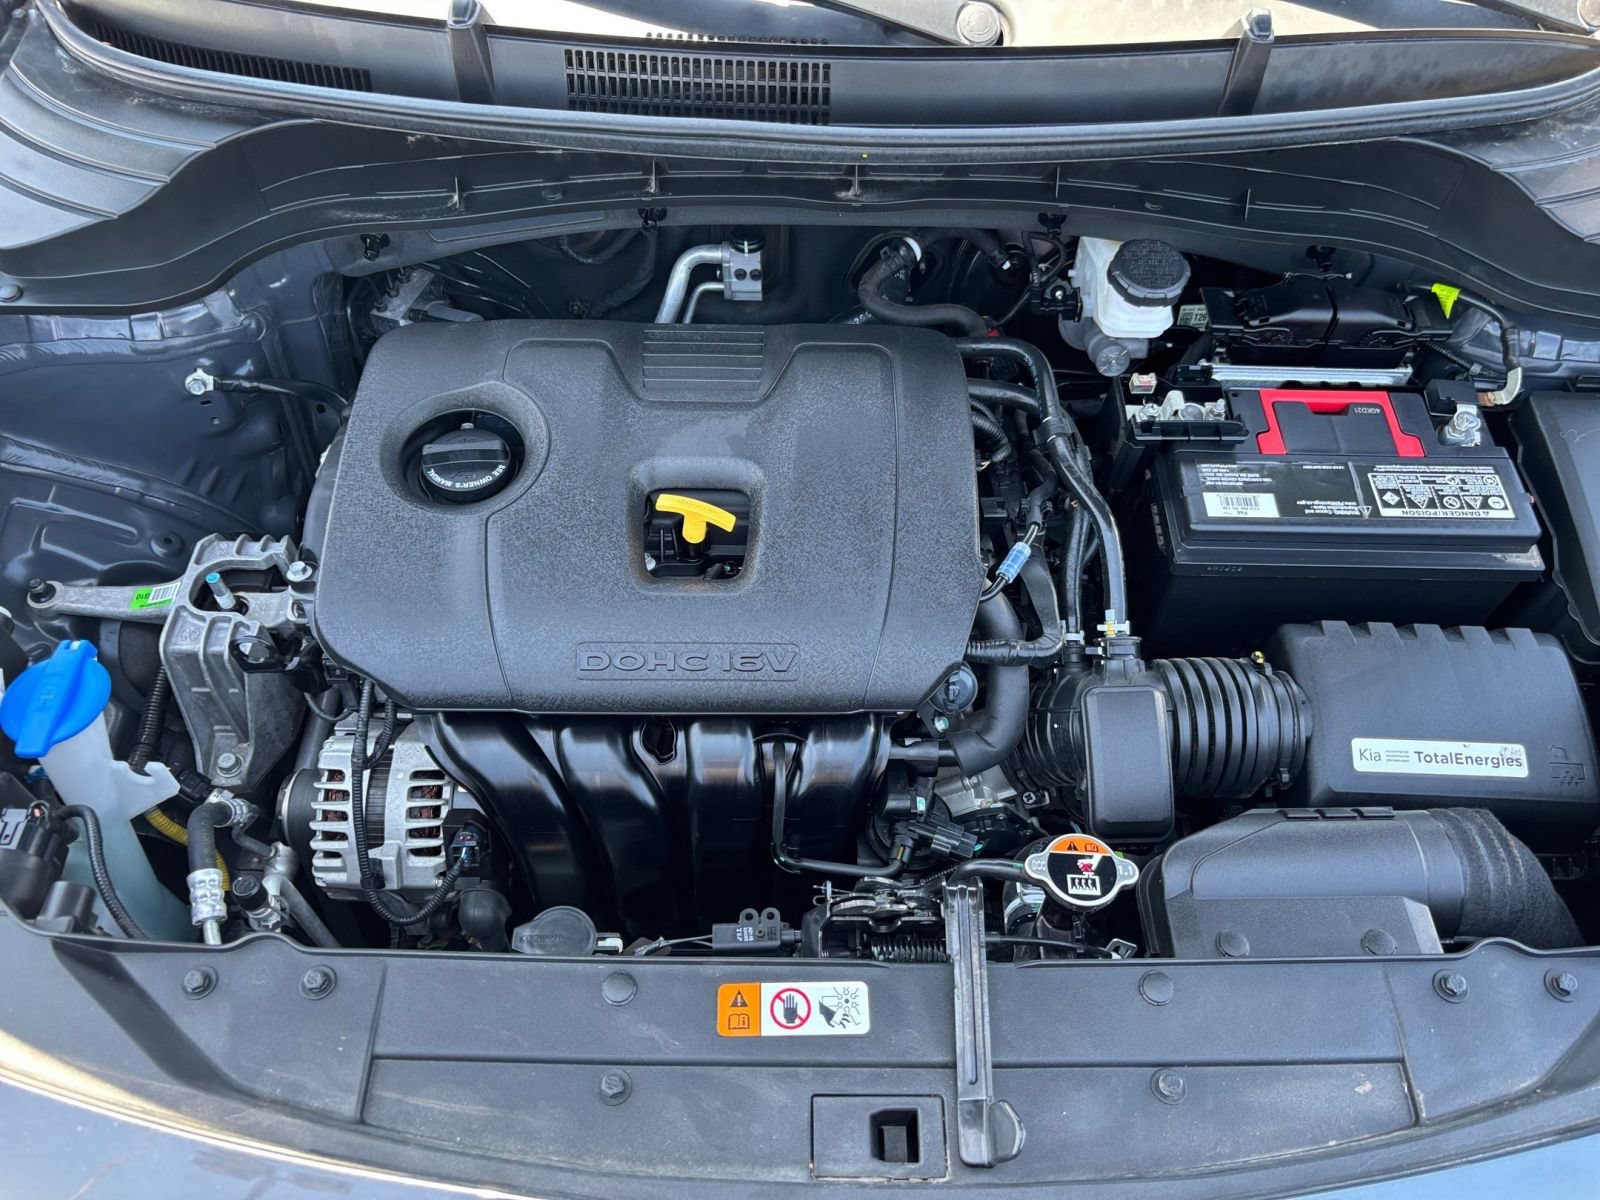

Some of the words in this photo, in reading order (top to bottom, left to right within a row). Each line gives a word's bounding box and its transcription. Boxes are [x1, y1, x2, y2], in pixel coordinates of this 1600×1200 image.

[491, 463, 506, 477] SEE
[426, 468, 453, 487] MANUAL
[455, 475, 493, 489] OWNER'S
[1401, 509, 1480, 517] DANGER/POISON
[579, 651, 709, 672] DOHC
[722, 651, 797, 673] 16V
[1358, 748, 1382, 763] Kia
[1414, 751, 1522, 769] TotalEnergies
[1117, 865, 1134, 876] 1.1
